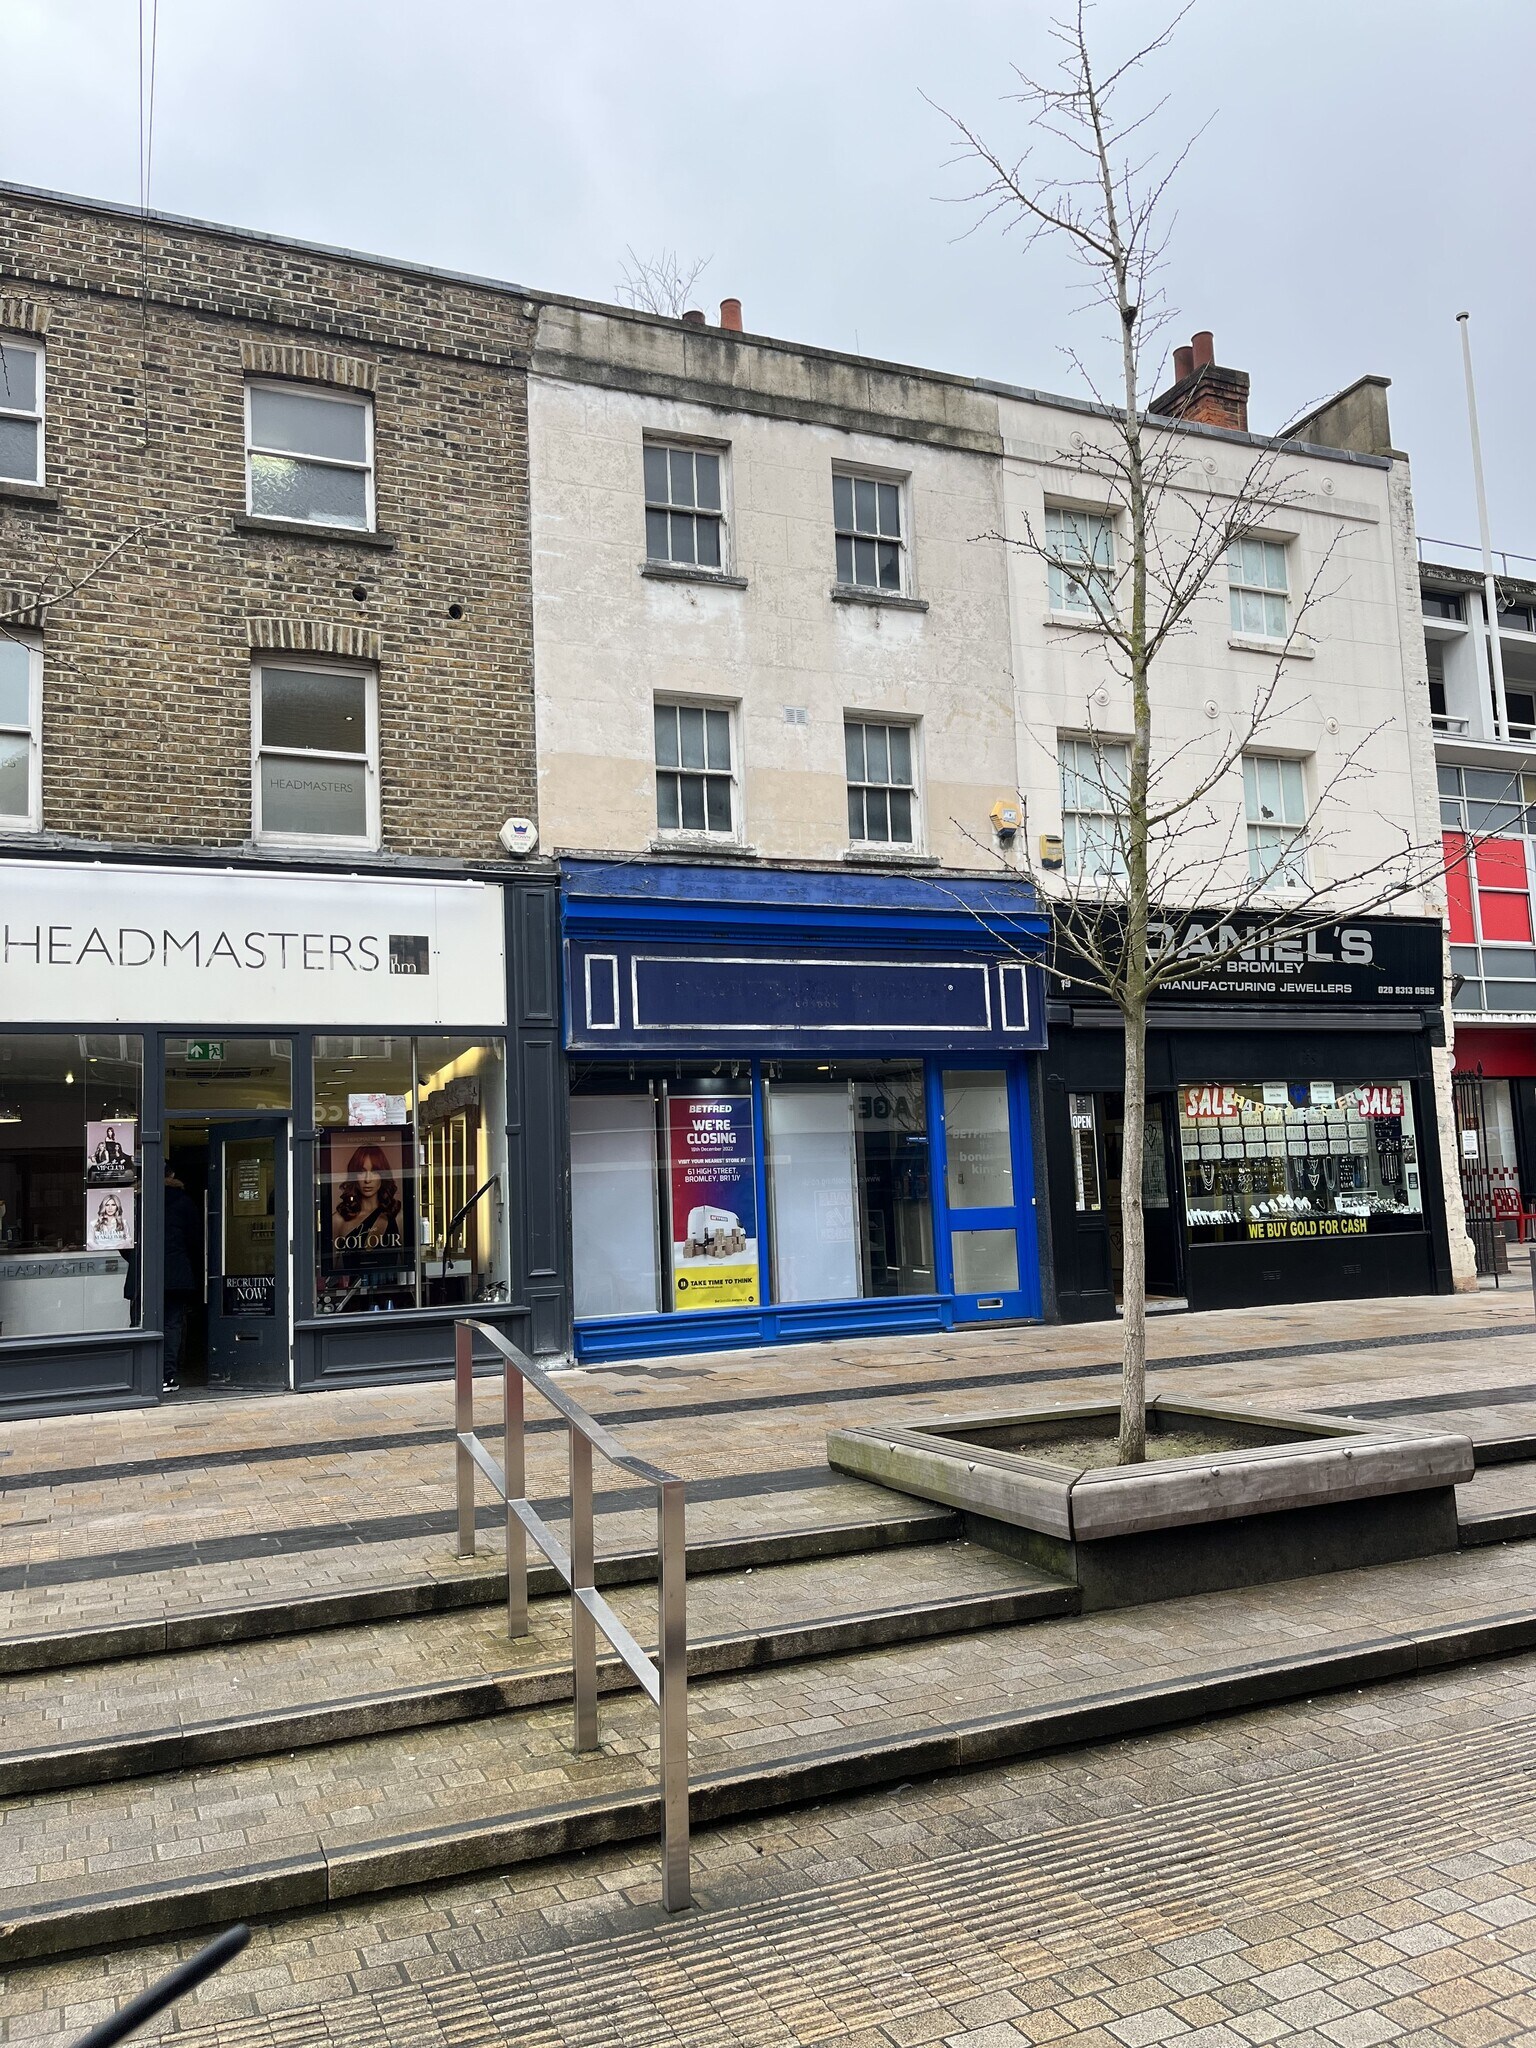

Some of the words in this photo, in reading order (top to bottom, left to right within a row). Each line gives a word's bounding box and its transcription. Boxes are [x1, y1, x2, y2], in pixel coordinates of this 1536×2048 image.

[270, 779, 353, 793] HEADMASTERS
[4, 924, 380, 972] HEADMASTERS
[1145, 920, 1374, 964] DANIEL'S
[1226, 961, 1304, 973] BROMLEY
[1159, 981, 1276, 992] MANUFACTURING
[1279, 983, 1353, 993] JEWELLERS
[1378, 986, 1393, 994] 020
[1395, 986, 1413, 995] 8313
[1415, 987, 1435, 995] 0585
[1187, 1087, 1236, 1116] SALE
[1360, 1087, 1401, 1115] SALE
[689, 1105, 732, 1113] BETFRED
[692, 1119, 731, 1131] WE'RE
[1072, 1115, 1092, 1129] OPEN
[687, 1133, 736, 1144] CLOSING
[960, 1152, 996, 1161] bonu
[972, 1164, 995, 1175] kin
[1248, 1224, 1264, 1238] WE
[1267, 1222, 1287, 1237] BUY
[1290, 1220, 1316, 1236] GOLD
[1319, 1219, 1338, 1234] FOR
[1341, 1218, 1367, 1233] CASH
[334, 1233, 402, 1250] COLOUR
[236, 1287, 267, 1300] NOW!
